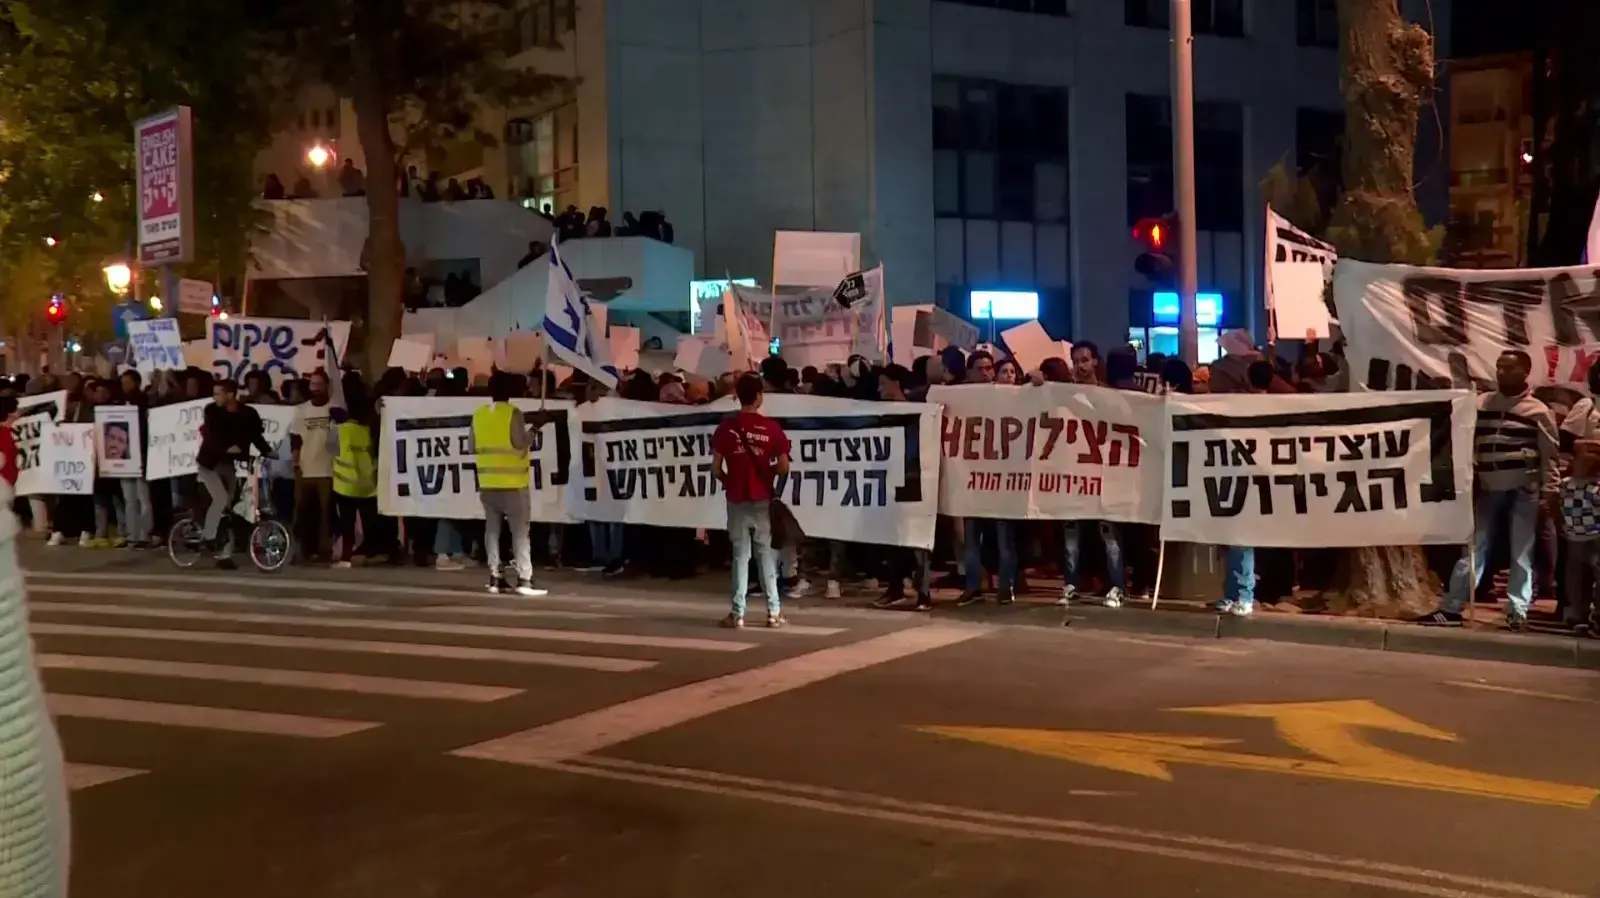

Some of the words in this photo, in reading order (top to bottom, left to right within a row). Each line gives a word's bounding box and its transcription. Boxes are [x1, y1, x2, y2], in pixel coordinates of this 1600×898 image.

[143, 143, 176, 170] CAKE
[212, 322, 299, 360] שיקום
[416, 436, 451, 459] את
[605, 439, 639, 464] את
[800, 436, 892, 463] עוצרים
[941, 416, 1023, 461] HELP
[1025, 412, 1140, 468] הצילו
[1270, 429, 1410, 465] עוצרים
[1203, 438, 1257, 467] את
[790, 469, 888, 508] הגירו
[967, 471, 1002, 491] הורג
[1005, 472, 1032, 491] הזה
[1038, 474, 1103, 497] הגירוש
